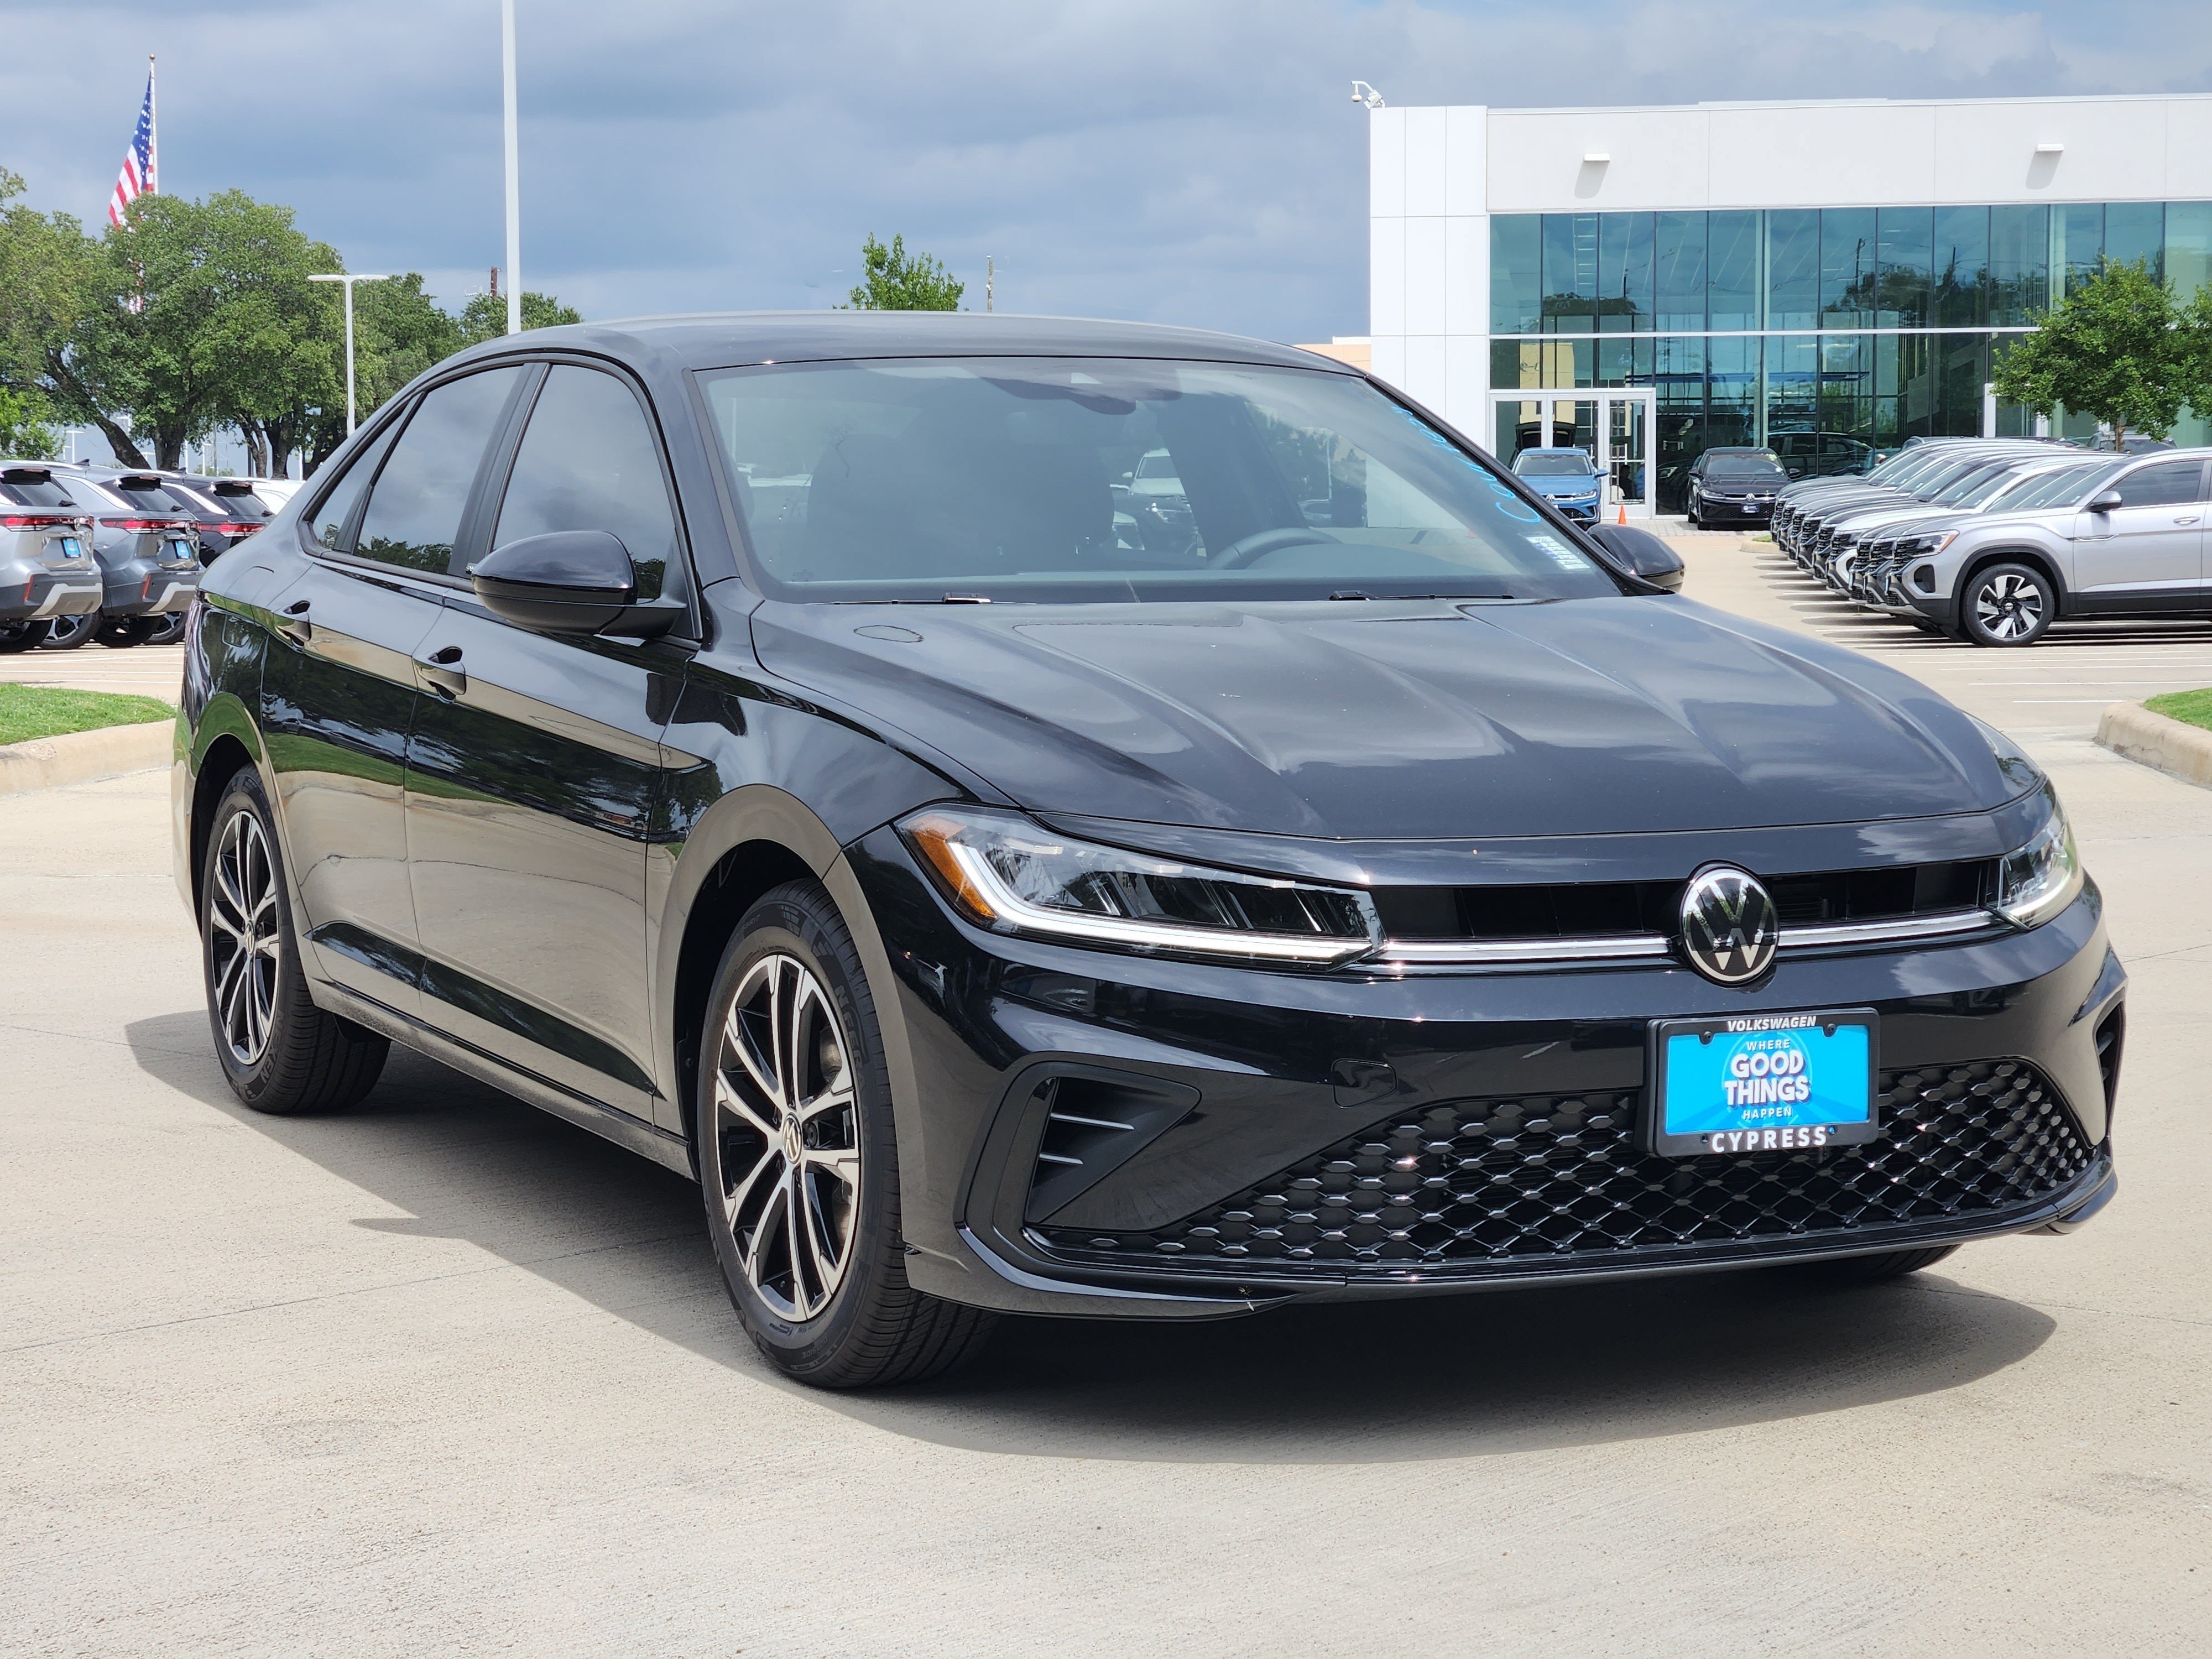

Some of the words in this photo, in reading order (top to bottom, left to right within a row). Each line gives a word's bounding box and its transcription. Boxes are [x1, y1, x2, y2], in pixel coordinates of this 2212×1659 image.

[1726, 1015, 1817, 1032] VOLKSWAGEN
[1746, 1039, 1791, 1051] WHERE
[1730, 1049, 1805, 1079] GOOD
[1724, 1075, 1811, 1107] THINGS
[1742, 1107, 1792, 1120] HAPPEN
[1712, 1126, 1827, 1153] CYPRESS
